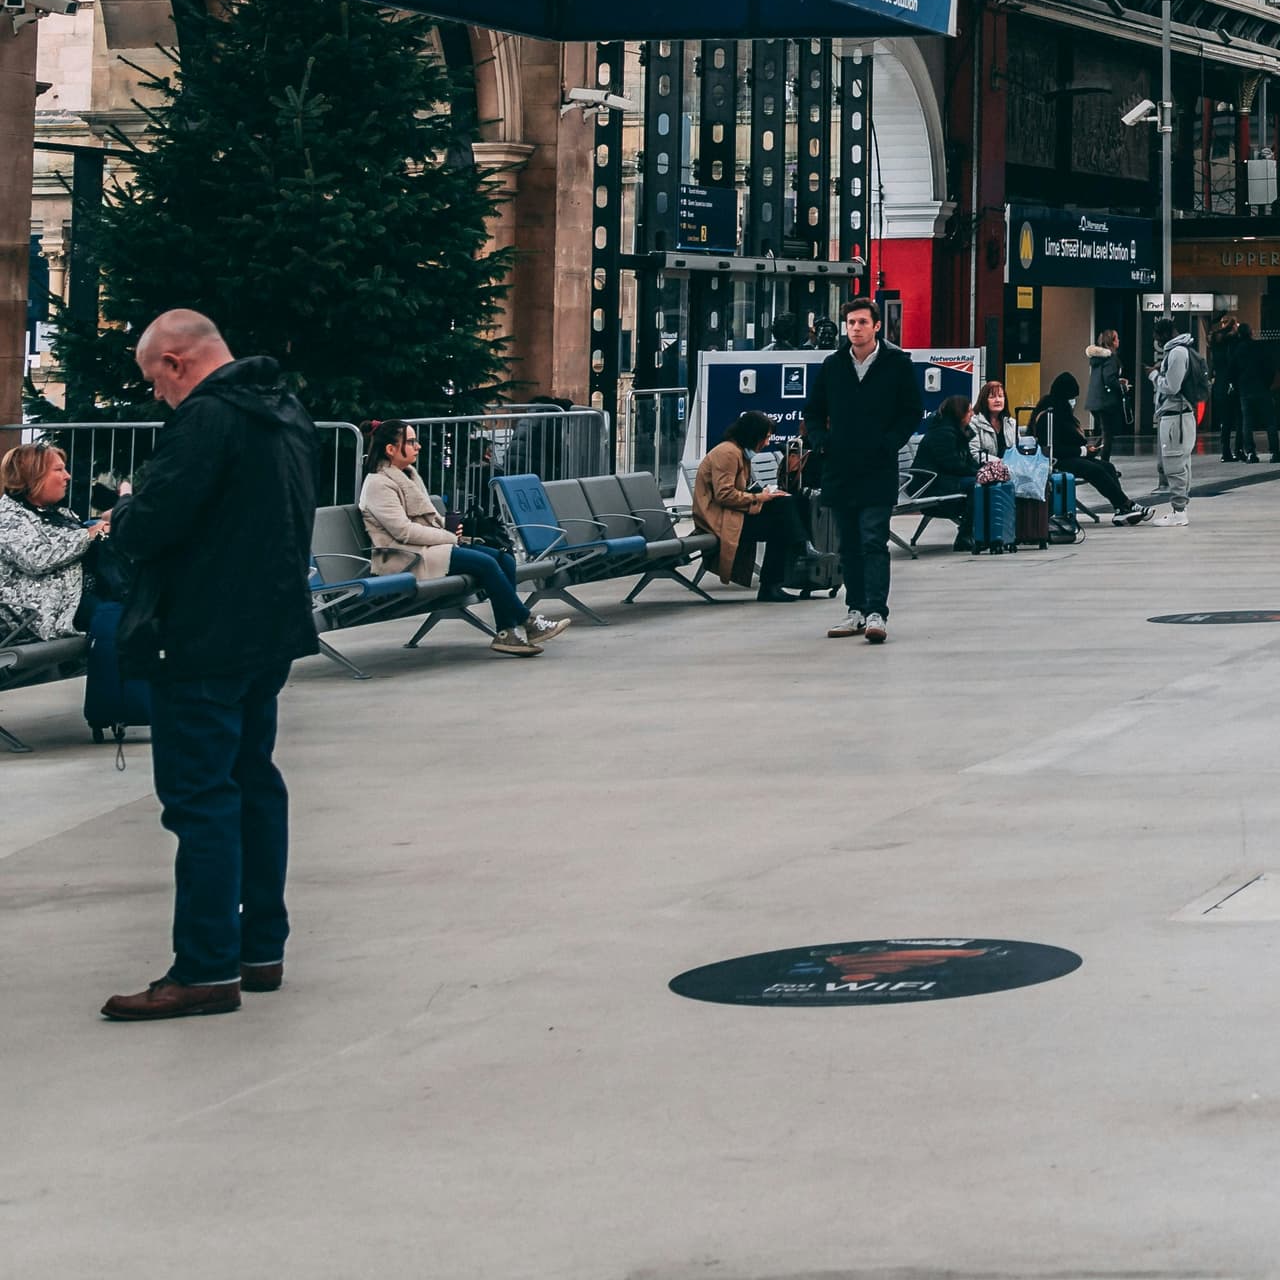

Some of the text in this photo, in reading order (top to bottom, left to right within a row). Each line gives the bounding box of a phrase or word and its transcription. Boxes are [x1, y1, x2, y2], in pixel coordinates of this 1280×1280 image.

[1044, 237, 1129, 261] Lime Street Low Level Station
[1222, 251, 1280, 267] UPPER
[785, 411, 796, 421] of
